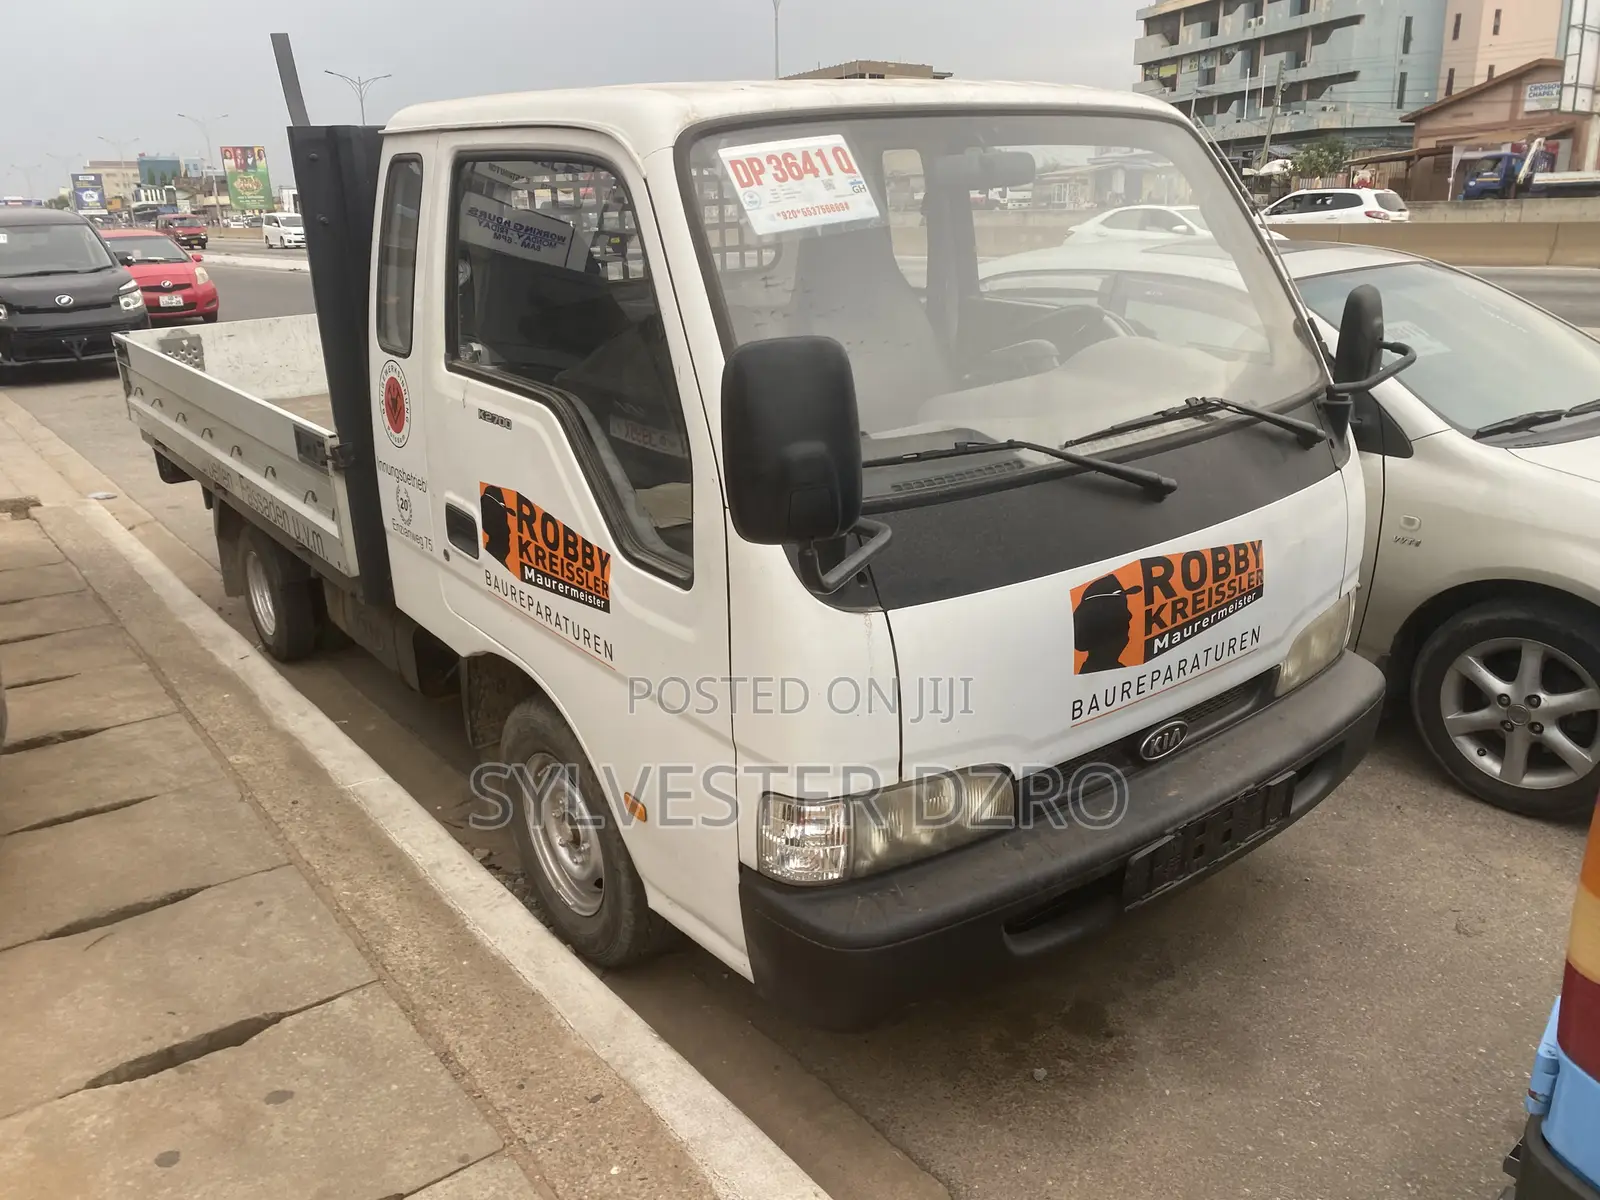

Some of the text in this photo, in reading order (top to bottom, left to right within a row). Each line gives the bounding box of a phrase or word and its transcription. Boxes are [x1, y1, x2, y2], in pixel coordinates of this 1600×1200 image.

[729, 146, 857, 188] DP 3641 Q
[851, 184, 867, 194] GH
[477, 408, 513, 430] K2700
[399, 497, 409, 511] 20
[516, 491, 611, 580] ROBBY
[518, 535, 609, 599] KREISSLER
[524, 565, 605, 609] Maurermeister
[1140, 540, 1264, 607] ROBBY
[485, 569, 613, 662] BAUREPARATUREN
[1144, 569, 1264, 637] KREISSLER
[1153, 591, 1257, 655] Maurermeister
[1071, 625, 1261, 721] BAUREPARATUREN
[1149, 727, 1181, 757] KIA
